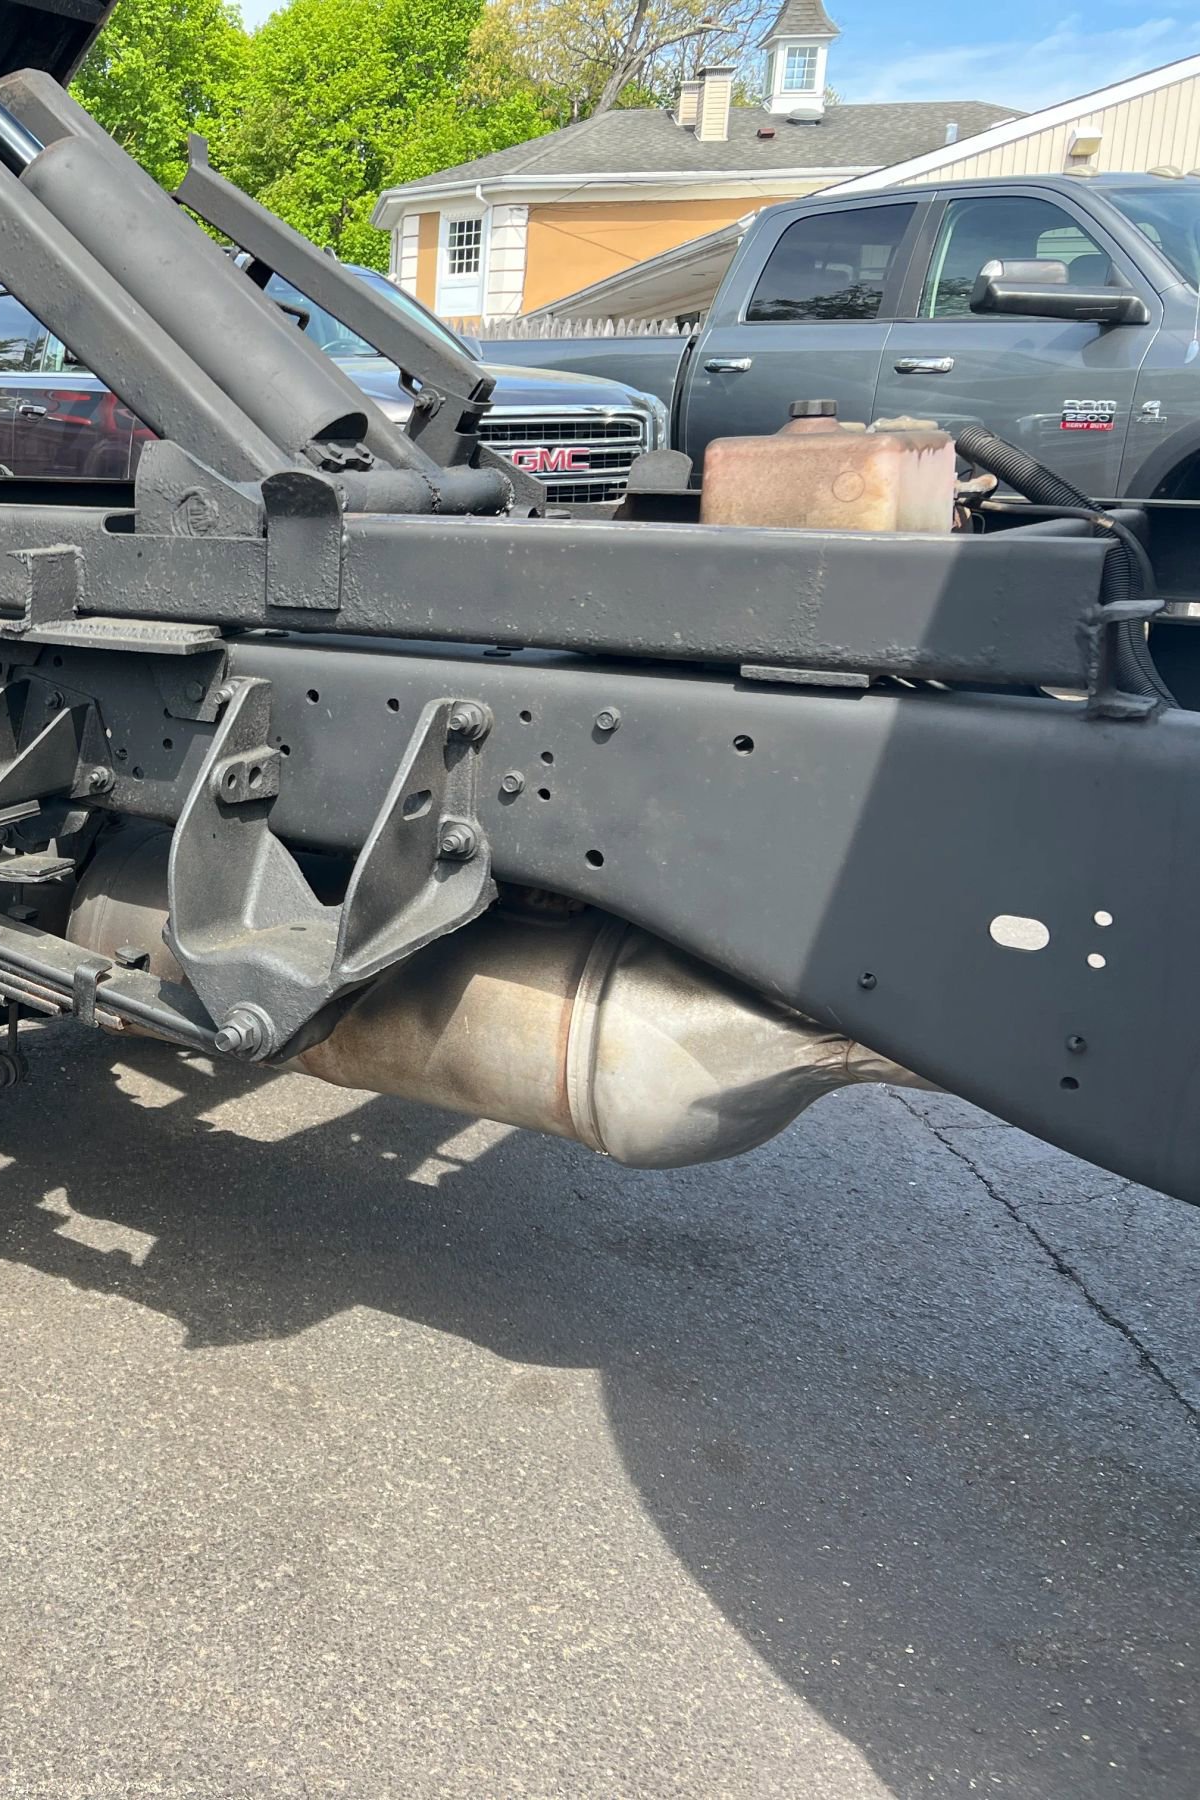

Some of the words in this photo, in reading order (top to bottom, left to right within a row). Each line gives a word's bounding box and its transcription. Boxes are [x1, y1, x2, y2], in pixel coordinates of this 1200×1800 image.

[1065, 413, 1110, 422] 2500
[1065, 422, 1089, 430] HEAVY
[1089, 422, 1109, 430] DUTY
[511, 446, 591, 473] GMC
